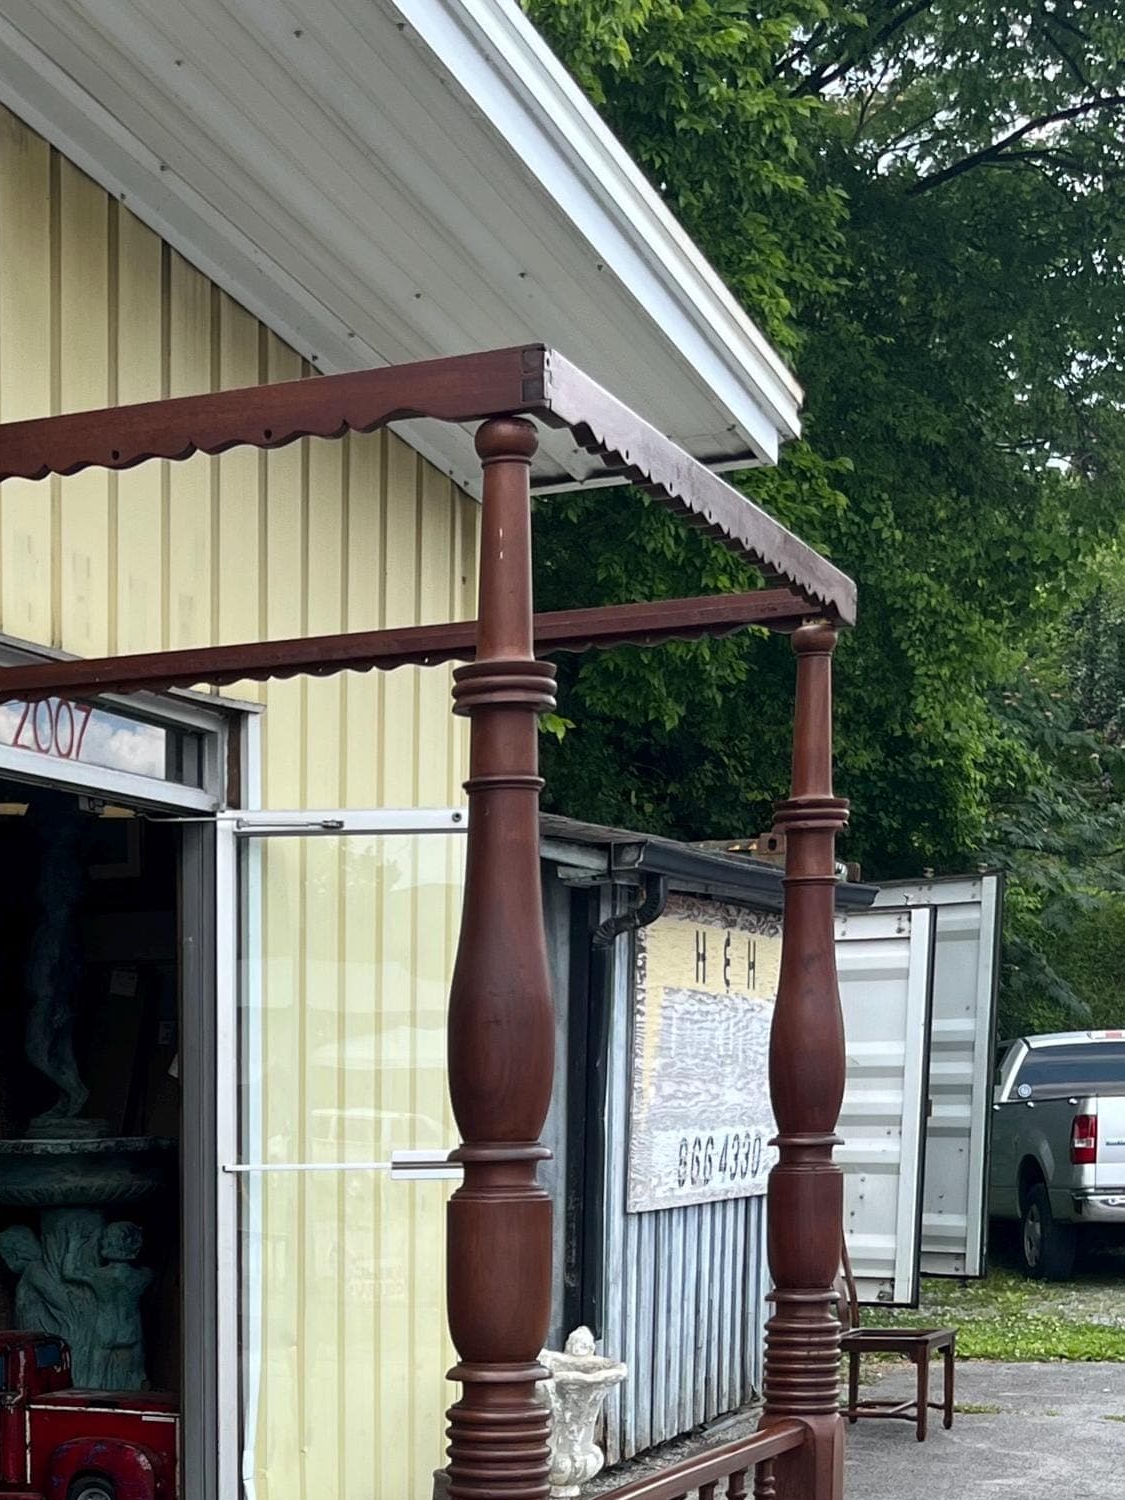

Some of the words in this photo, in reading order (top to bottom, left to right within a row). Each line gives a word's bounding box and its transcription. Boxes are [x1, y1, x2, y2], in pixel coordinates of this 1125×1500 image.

[12, 699, 92, 761] 2007
[695, 929, 707, 985] H
[747, 939, 757, 991] H
[718, 1132, 762, 1183] 4330
